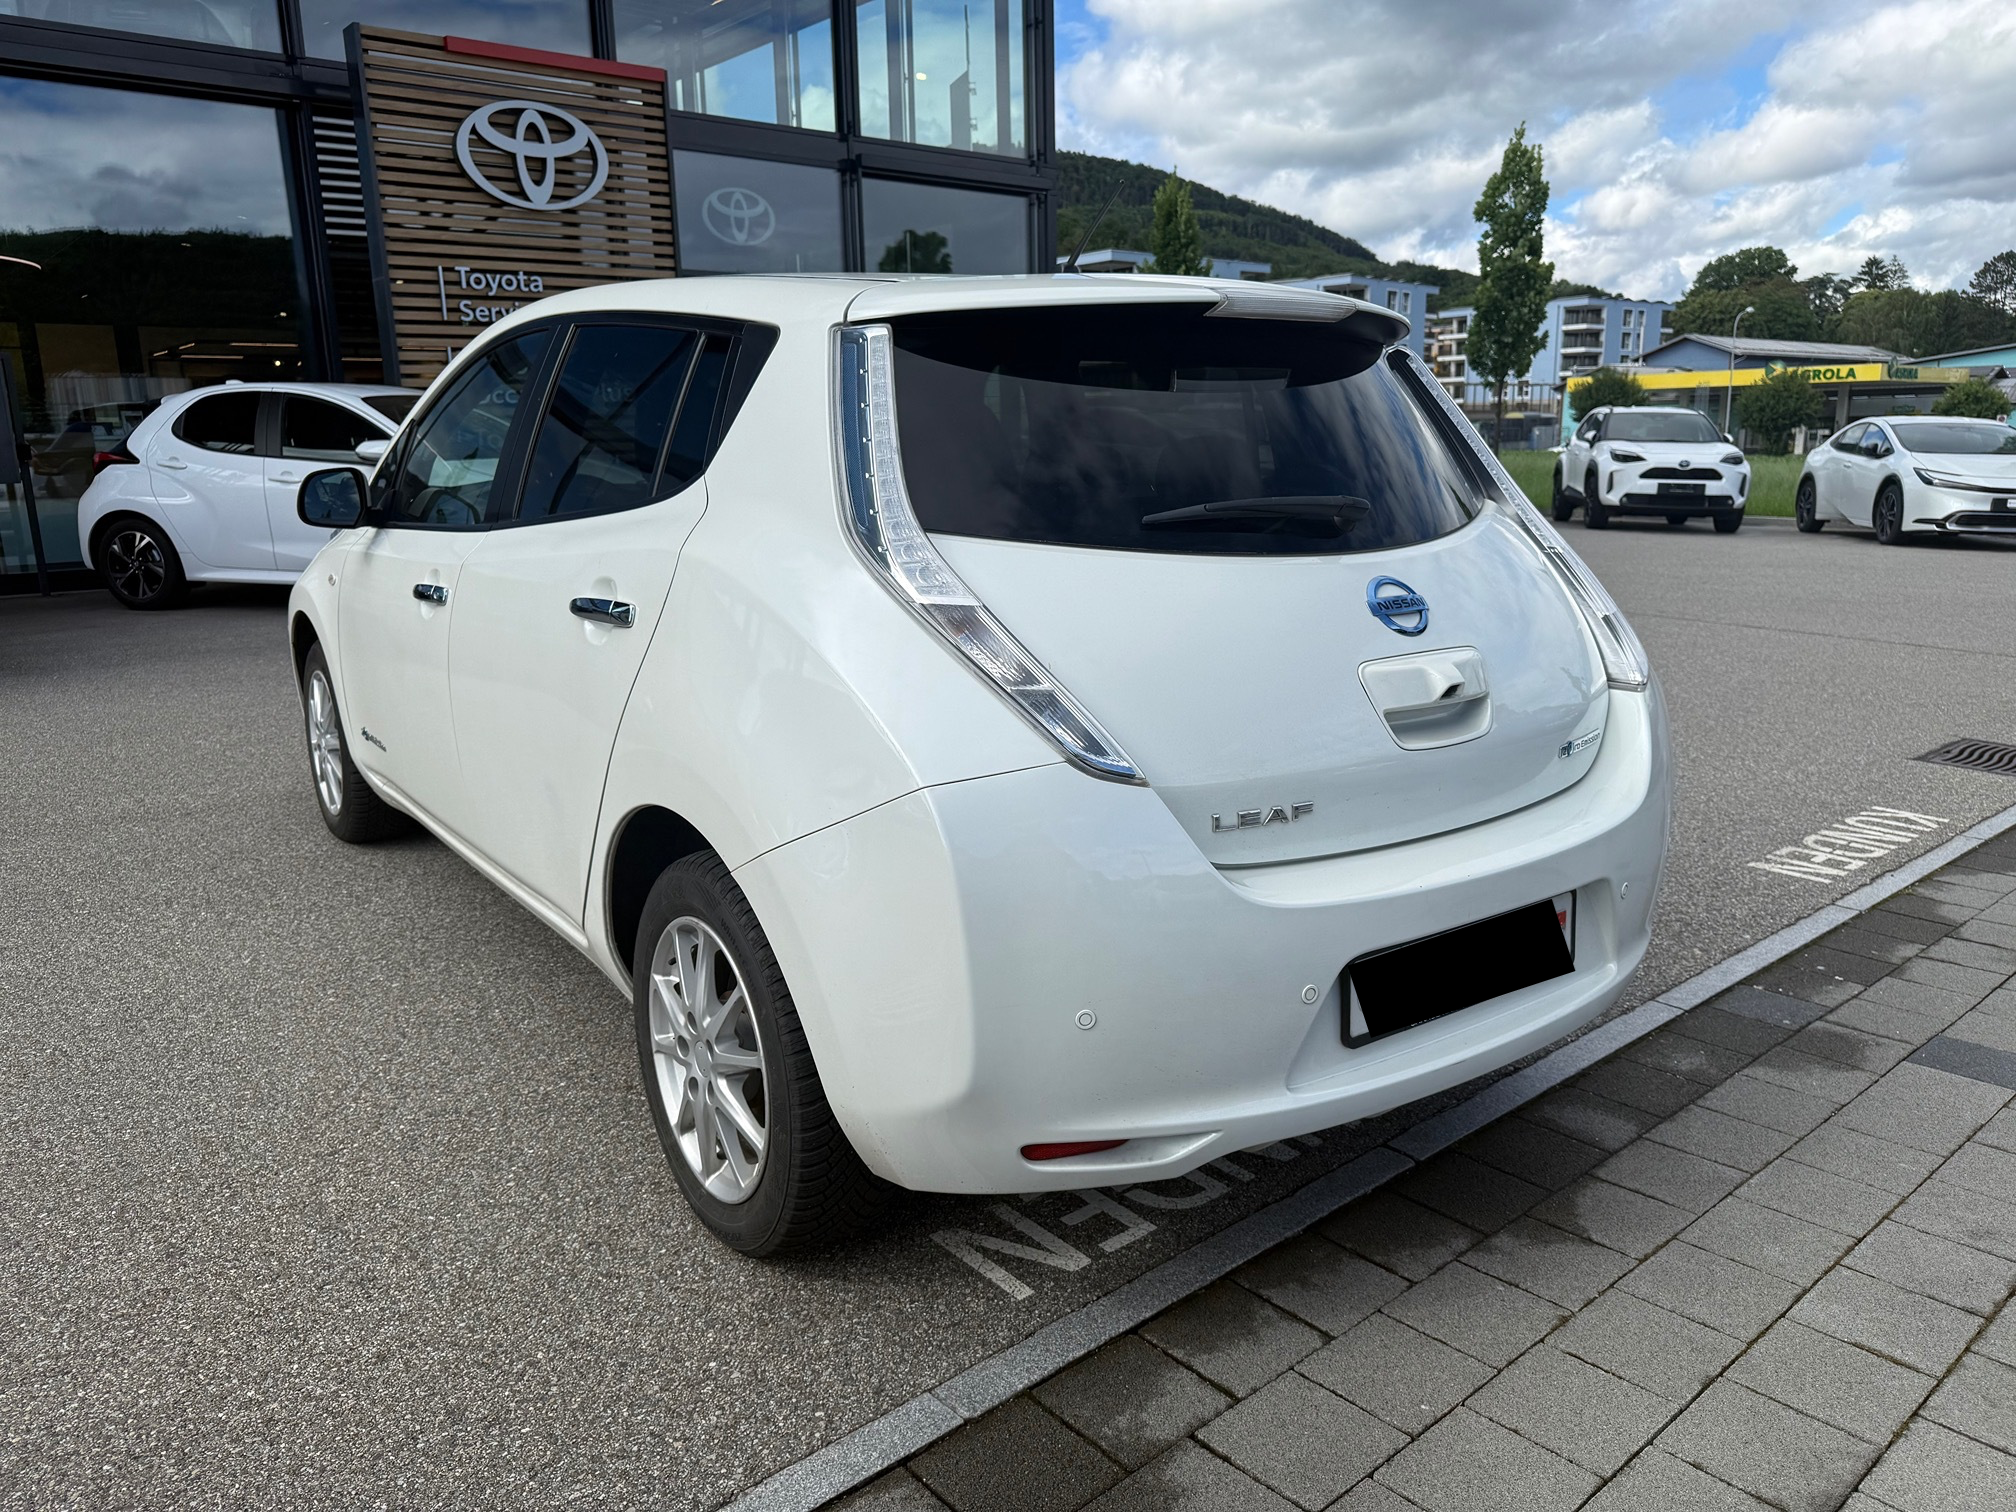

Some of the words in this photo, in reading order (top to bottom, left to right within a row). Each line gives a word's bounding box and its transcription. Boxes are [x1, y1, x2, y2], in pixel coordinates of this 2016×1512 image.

[454, 266, 544, 296] Toyota
[459, 300, 519, 322] Servi
[1376, 597, 1426, 611] NISSAN
[1211, 800, 1314, 833] LEAF
[1747, 806, 1950, 884] KUNDEN
